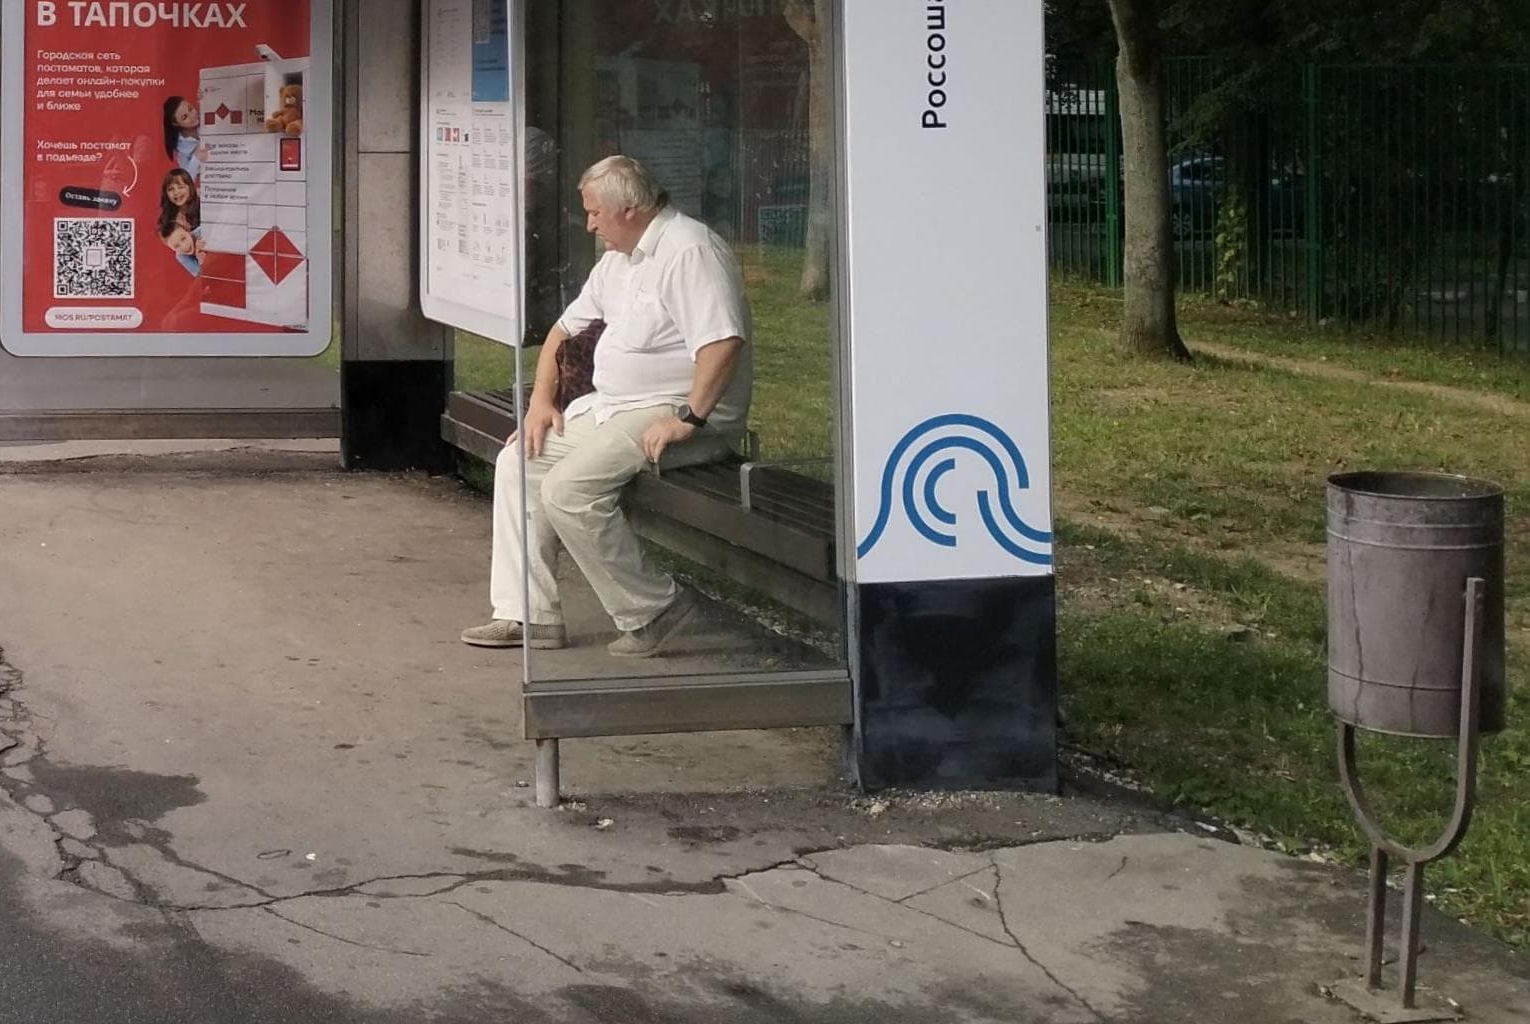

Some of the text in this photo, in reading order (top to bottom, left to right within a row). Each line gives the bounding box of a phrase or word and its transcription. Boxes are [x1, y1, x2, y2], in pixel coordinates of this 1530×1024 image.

[37, 1, 248, 28] В ТАПОЧКАХ
[36, 49, 121, 61] Городская сеть
[106, 65, 151, 75] которая
[36, 76, 165, 87] делает онлайн-покупки
[36, 88, 139, 99] для семьи удобнее
[36, 101, 82, 111] и ближе
[36, 139, 132, 150] Хочешь постамат
[36, 152, 103, 163] в подъезде?
